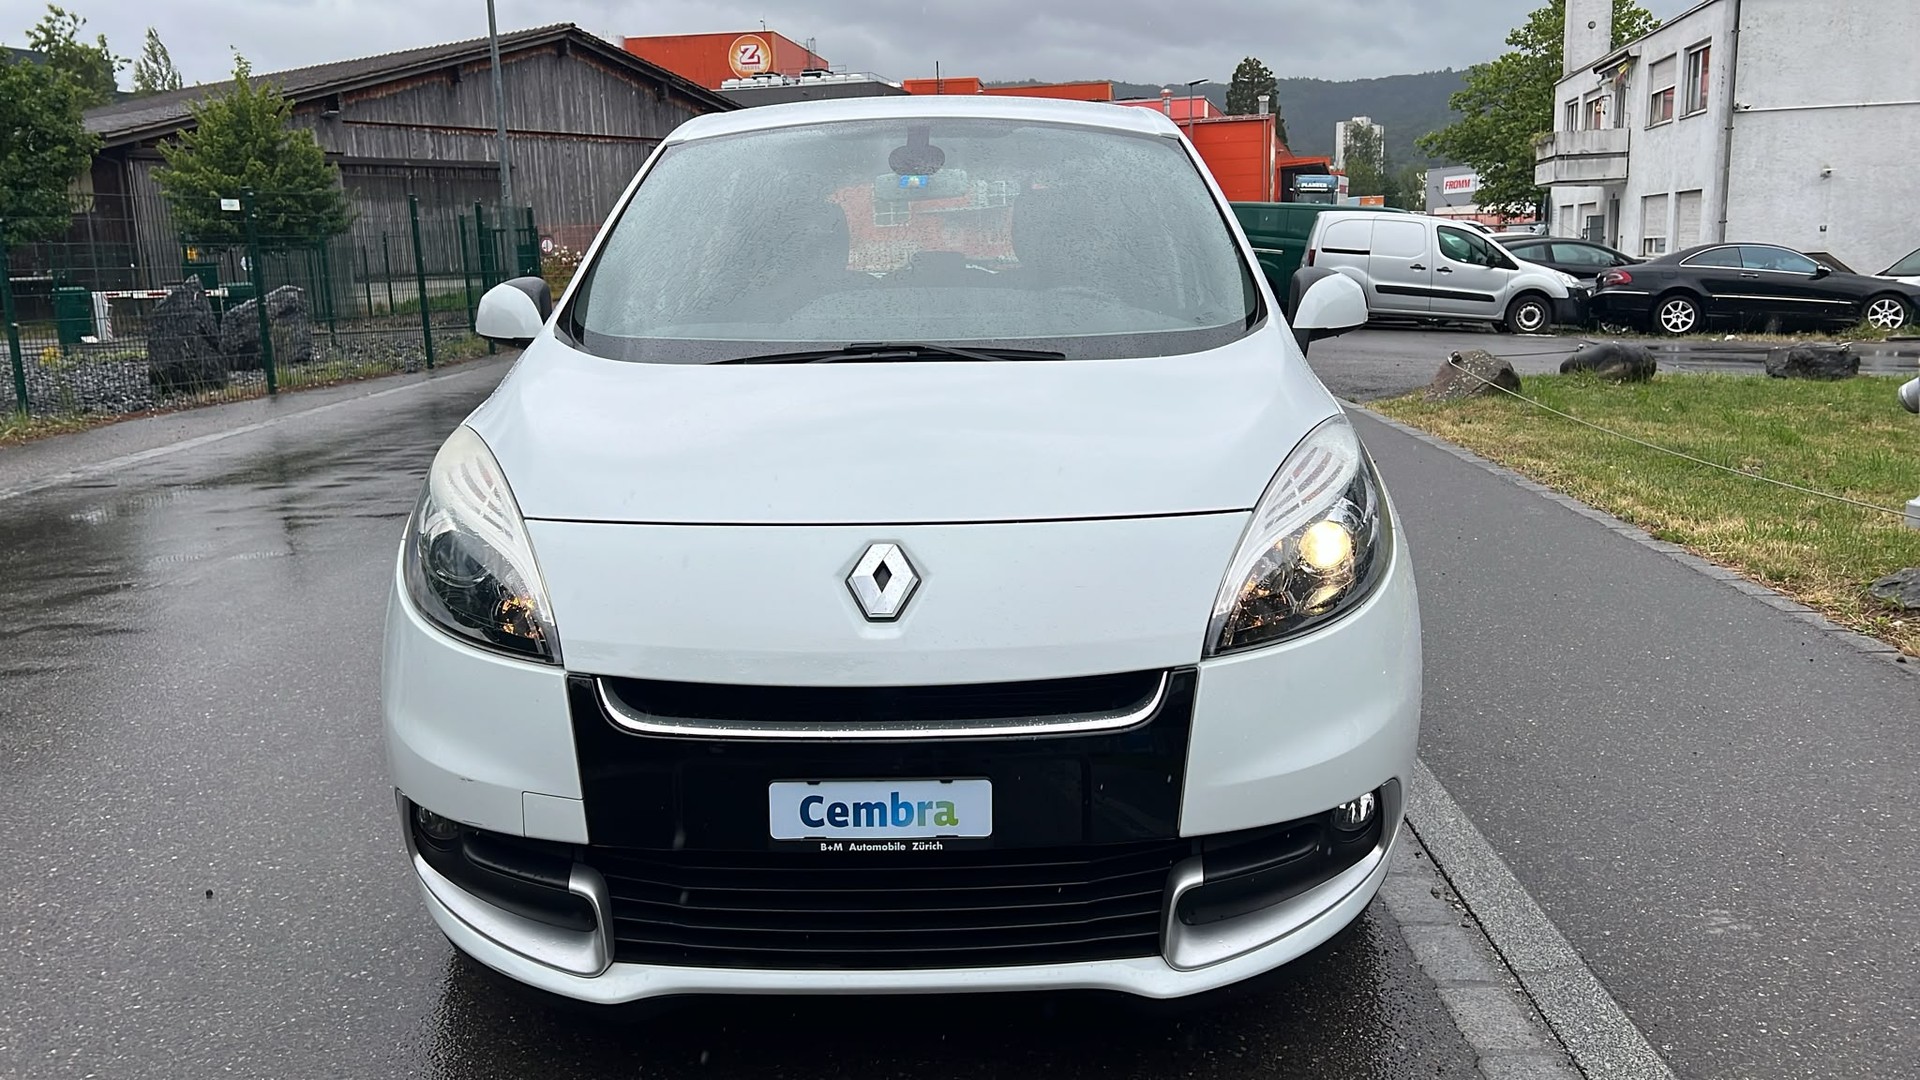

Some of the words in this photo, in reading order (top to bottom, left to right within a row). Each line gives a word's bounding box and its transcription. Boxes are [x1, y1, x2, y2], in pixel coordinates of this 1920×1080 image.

[740, 44, 760, 64] Z
[1445, 178, 1471, 190] FROMM
[800, 791, 959, 828] Cembra
[820, 842, 843, 851] B+M
[849, 842, 906, 851] Automobile
[912, 841, 943, 851] Zürich
